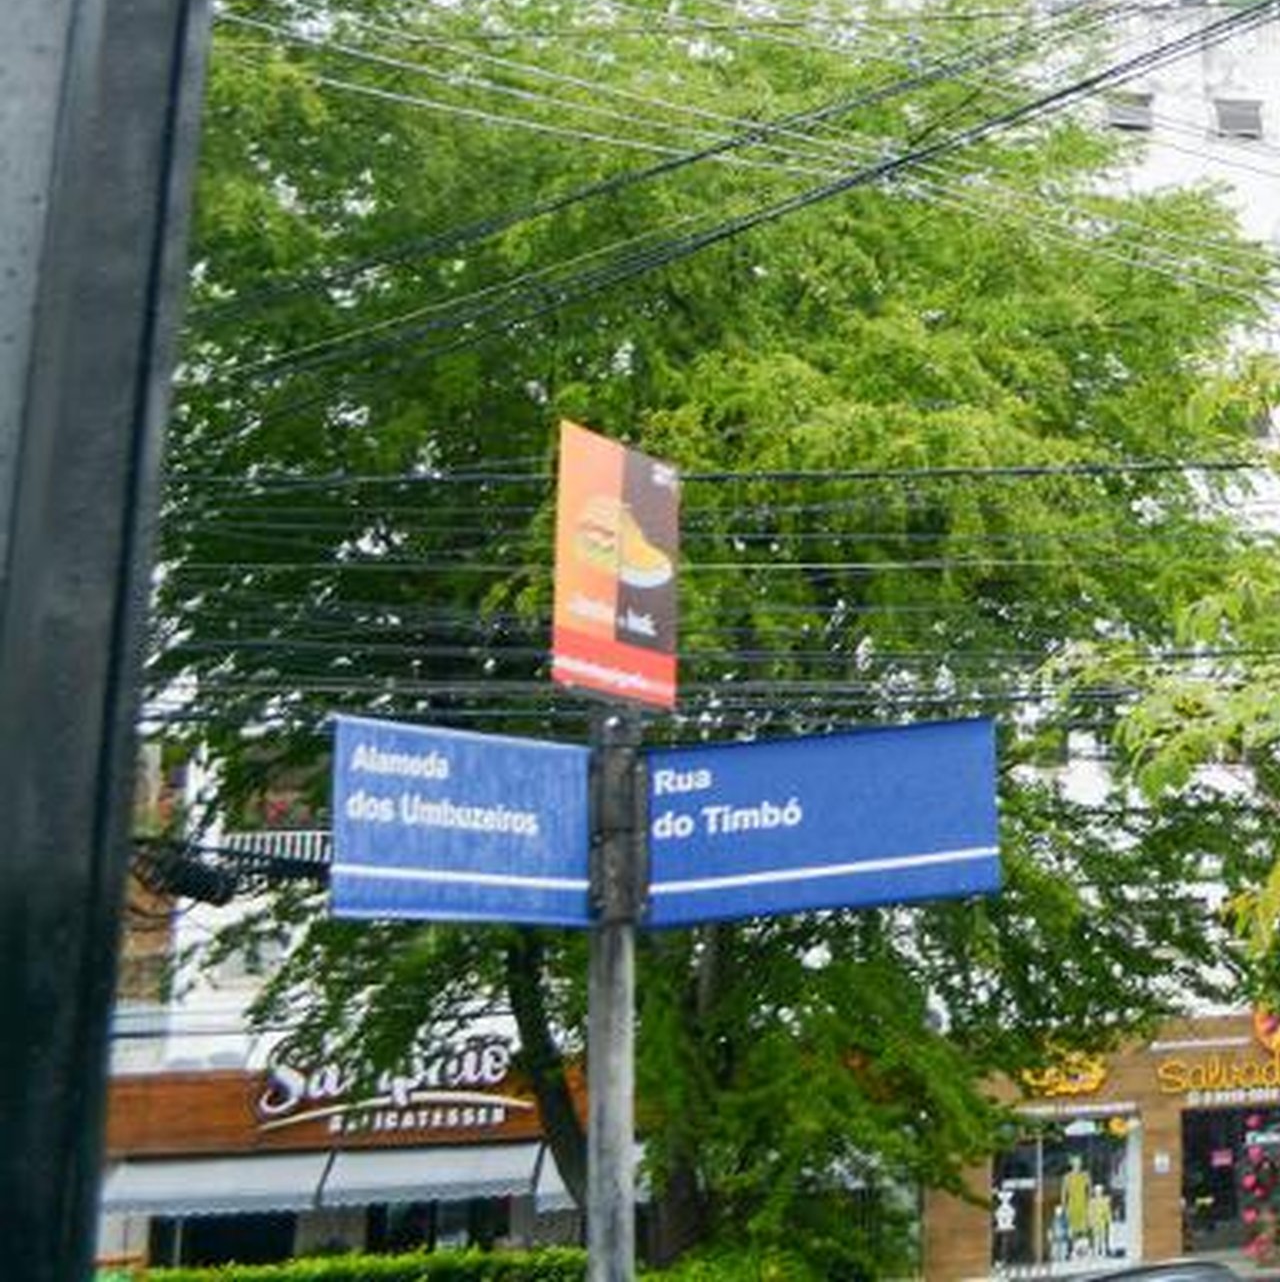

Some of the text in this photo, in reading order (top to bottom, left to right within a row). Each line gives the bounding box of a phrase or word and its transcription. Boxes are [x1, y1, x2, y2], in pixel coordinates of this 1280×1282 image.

[351, 743, 449, 780] Alameda
[653, 770, 712, 795] Rua
[346, 790, 539, 836] dos Umbuzeiros
[652, 797, 803, 839] do Timbó
